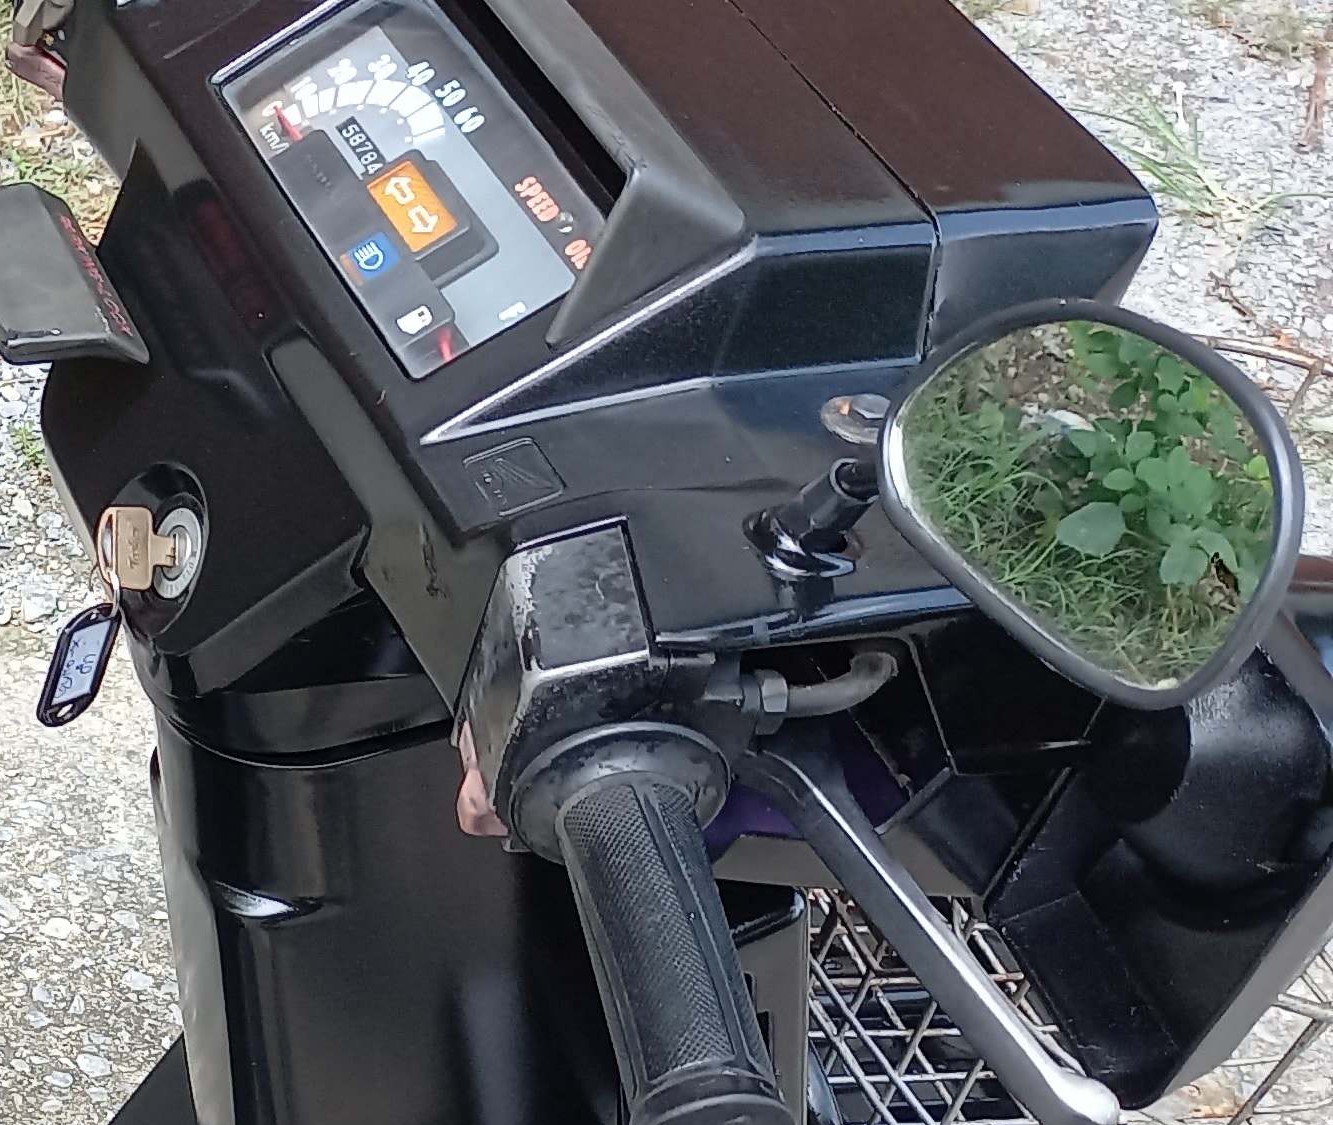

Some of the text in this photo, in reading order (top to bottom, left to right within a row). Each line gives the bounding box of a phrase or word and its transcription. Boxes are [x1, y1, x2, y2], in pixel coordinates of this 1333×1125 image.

[406, 61, 435, 86] 40
[434, 79, 466, 107] 50
[454, 107, 485, 133] 60
[341, 123, 384, 175] 58784
[514, 176, 559, 222] SPEED
